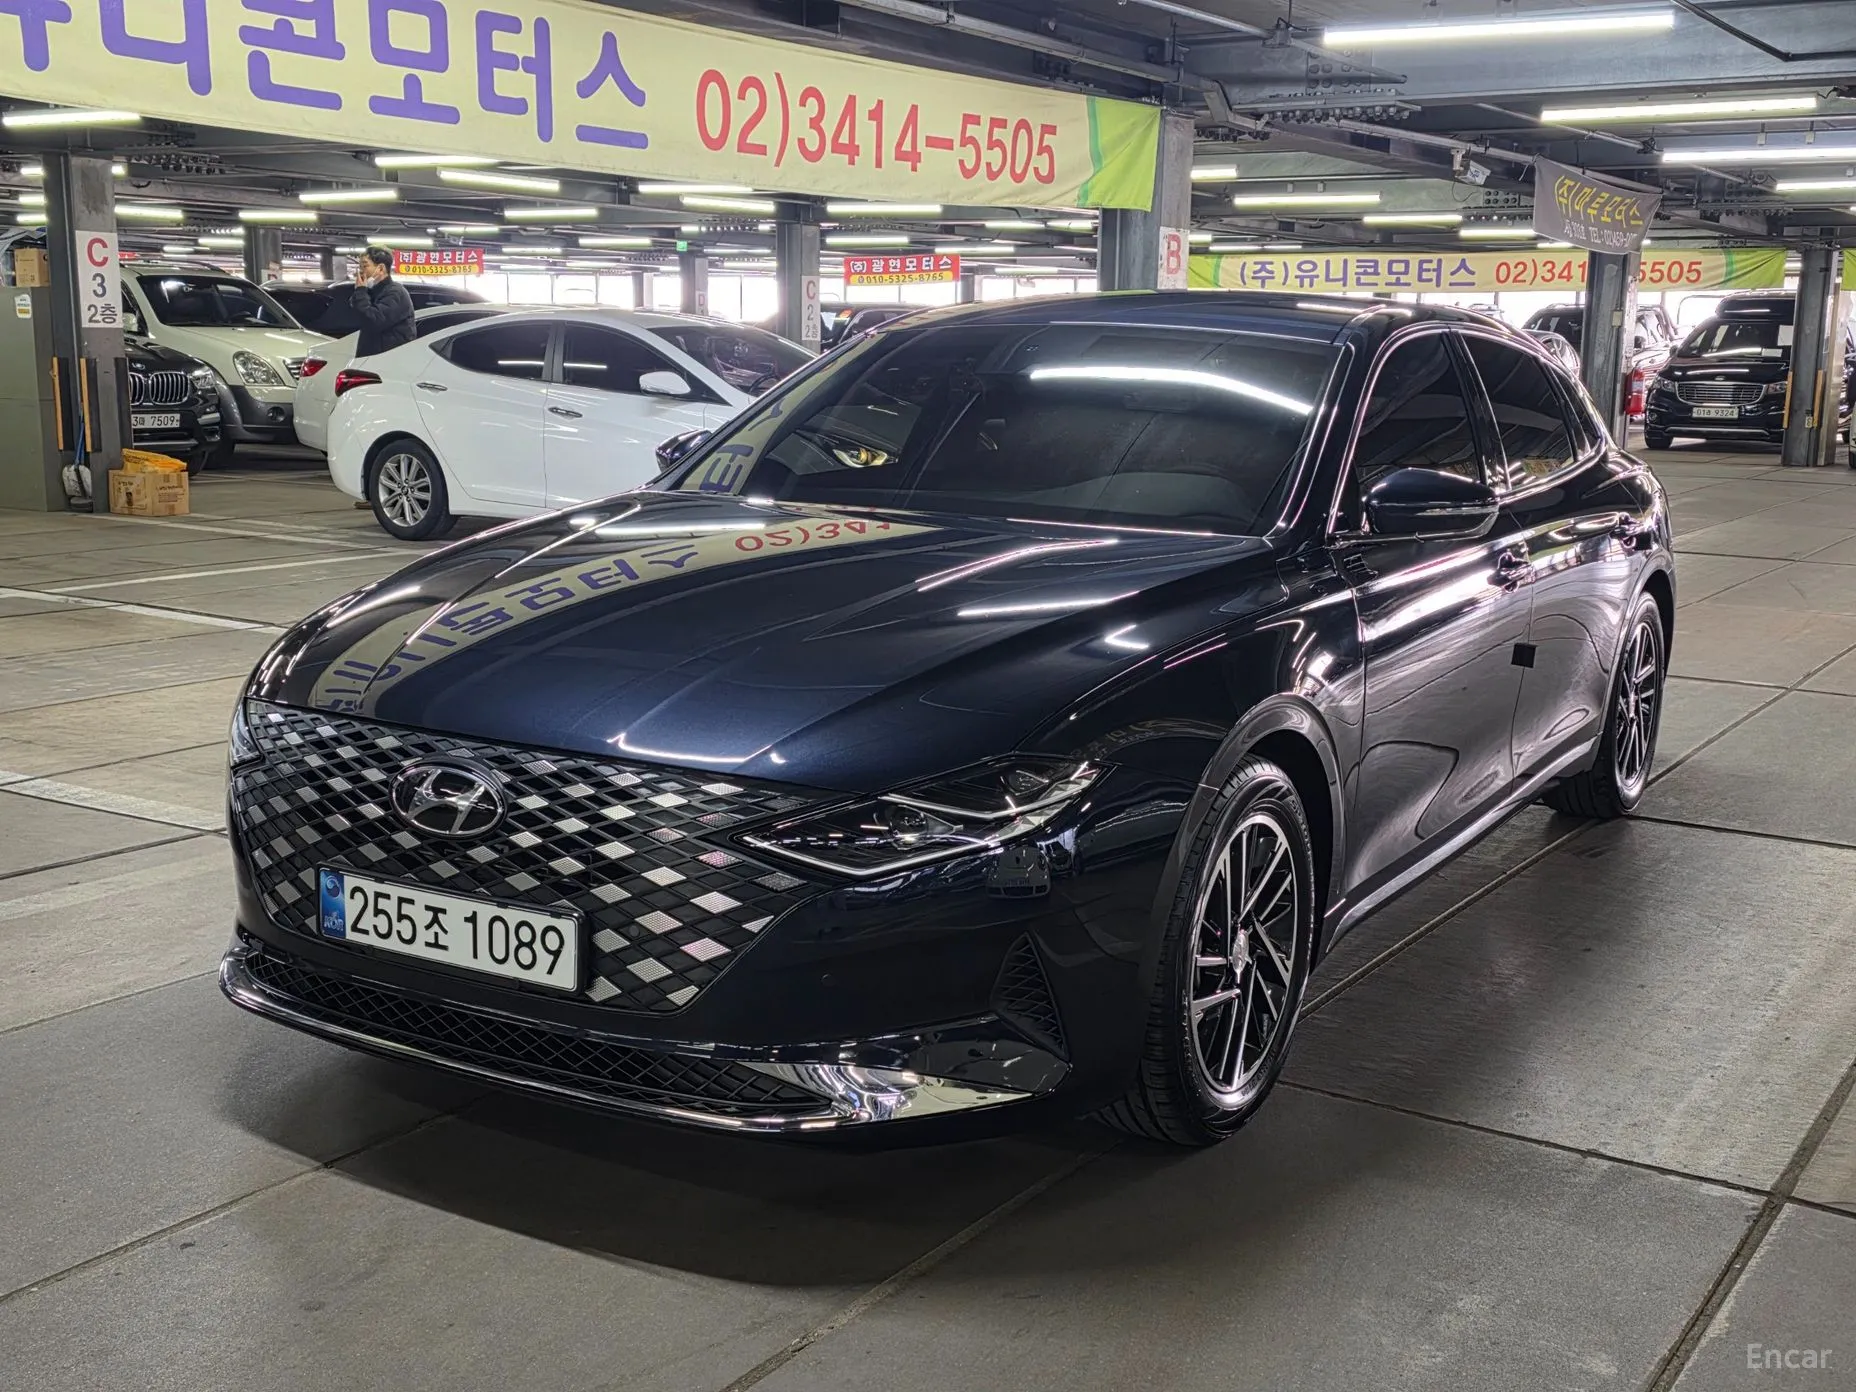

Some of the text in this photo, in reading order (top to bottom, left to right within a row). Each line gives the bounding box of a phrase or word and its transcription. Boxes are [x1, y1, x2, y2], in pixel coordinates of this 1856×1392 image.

[696, 69, 1058, 184] 02)3414-5505
[87, 237, 109, 267] C
[1166, 233, 1181, 275] B
[93, 272, 107, 298] 3
[1240, 257, 1476, 289] (주)유니콘모터스
[806, 280, 816, 300] C
[87, 303, 118, 325] 2층
[807, 303, 814, 321] 2
[151, 415, 175, 427] 7509
[1714, 409, 1735, 417] 9324
[350, 886, 565, 975] 255조 1089
